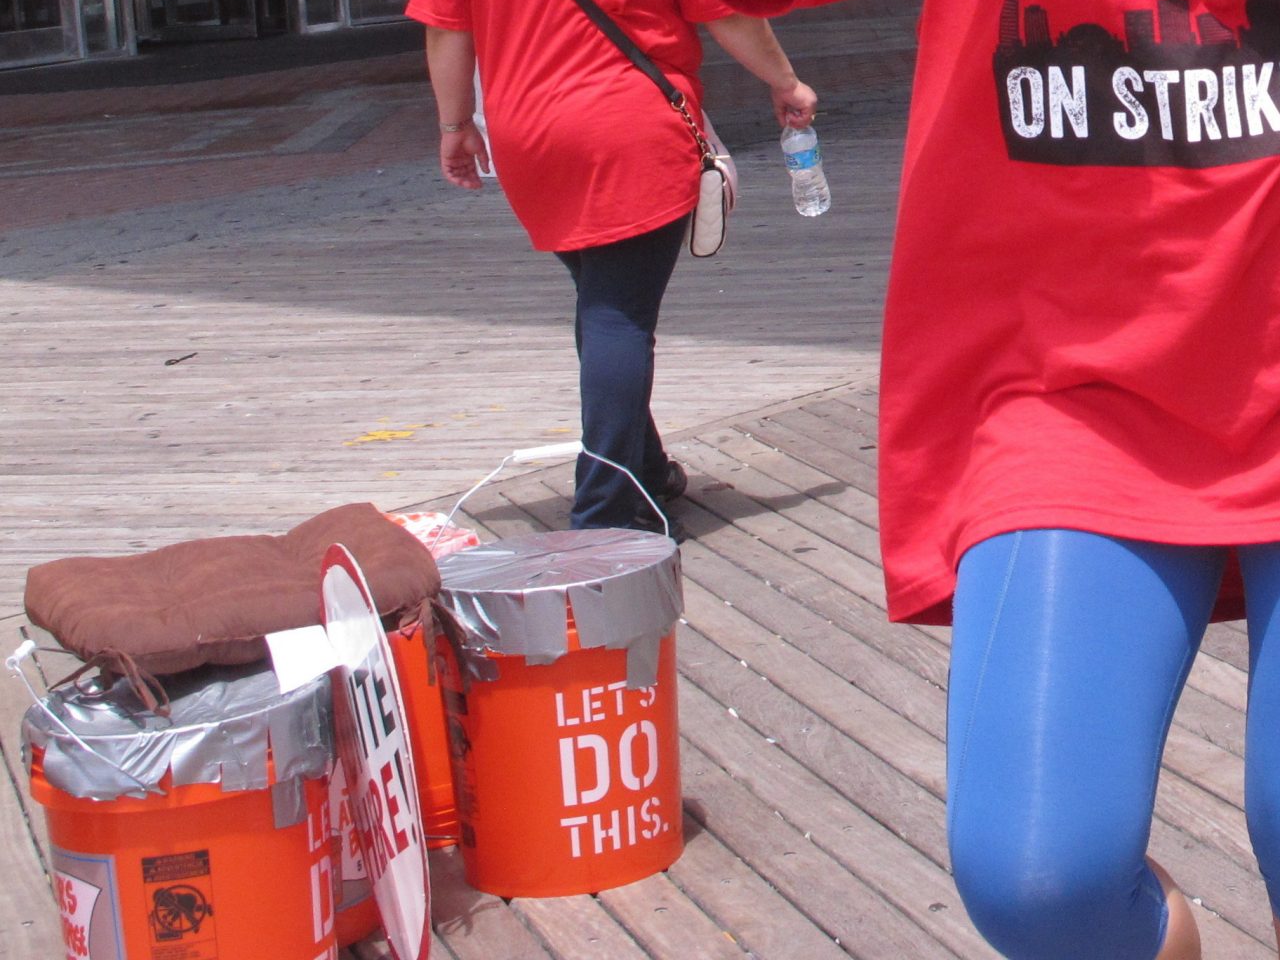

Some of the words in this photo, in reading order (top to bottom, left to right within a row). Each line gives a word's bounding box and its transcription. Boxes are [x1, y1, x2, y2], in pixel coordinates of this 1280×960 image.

[1007, 65, 1088, 138] ON
[559, 719, 659, 807] DO
[560, 796, 669, 858] THIS.
